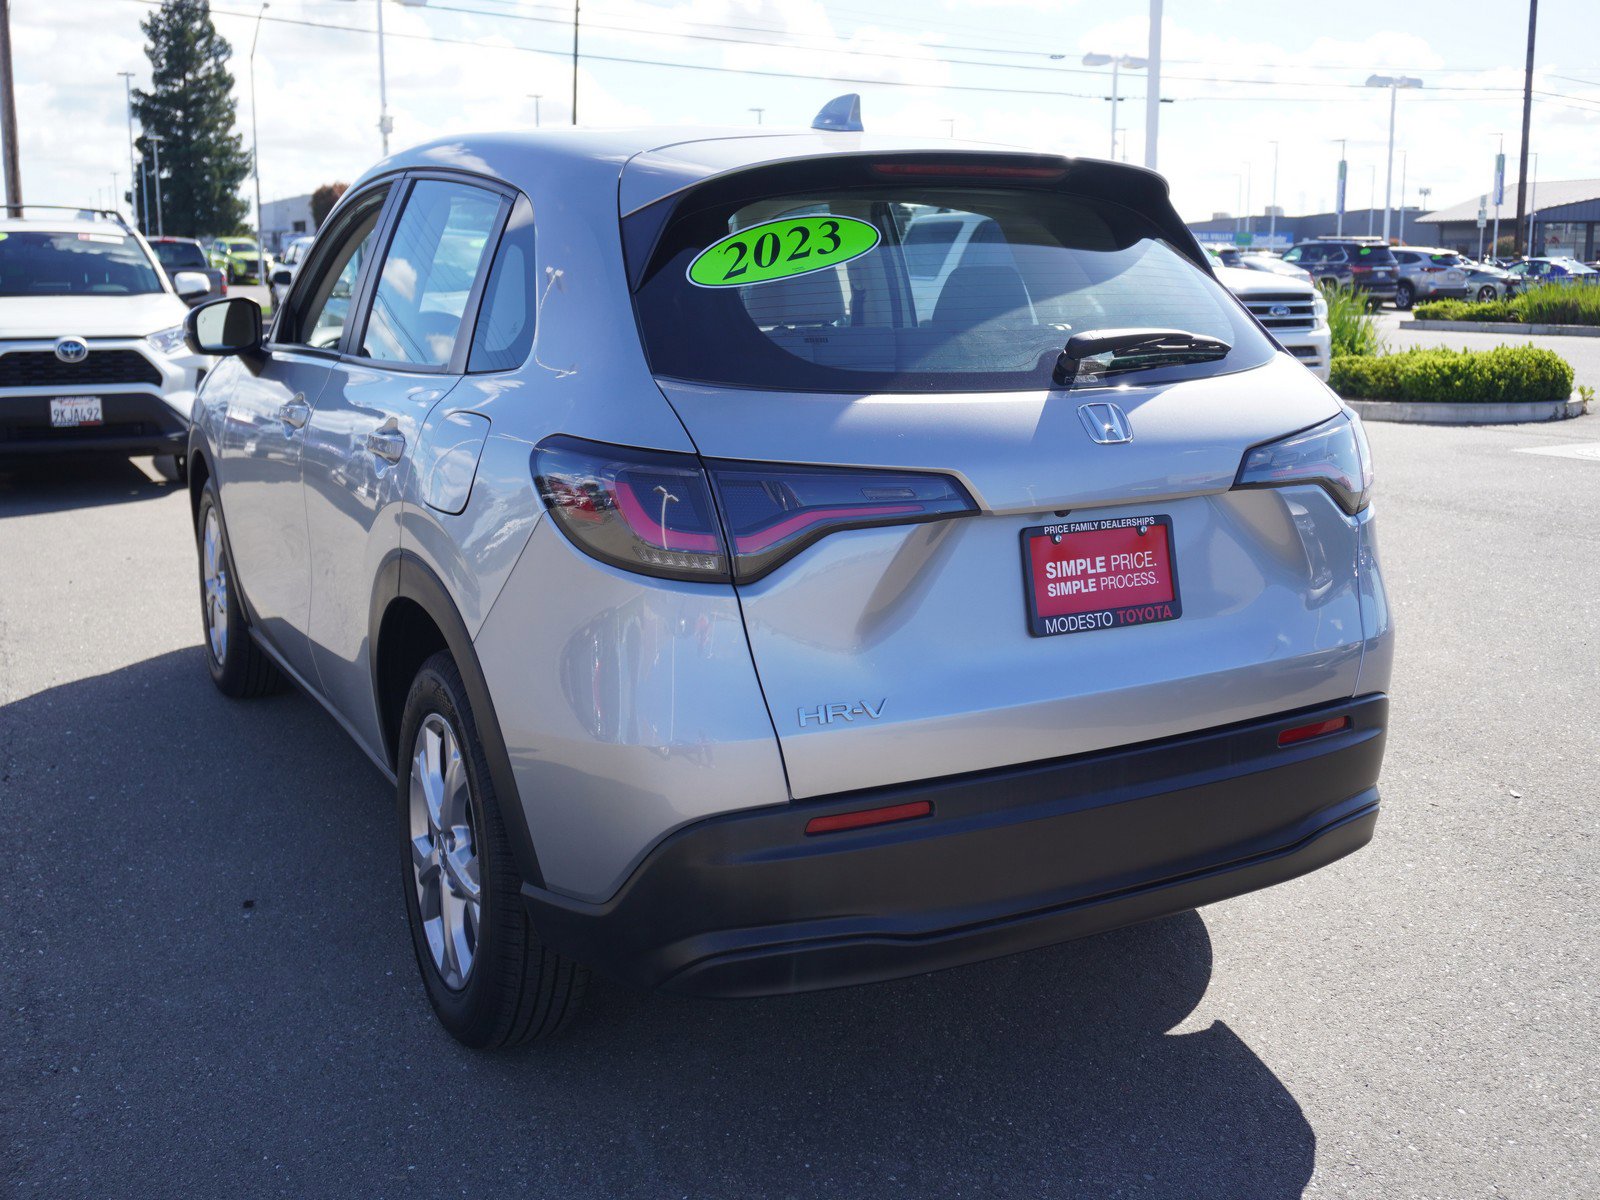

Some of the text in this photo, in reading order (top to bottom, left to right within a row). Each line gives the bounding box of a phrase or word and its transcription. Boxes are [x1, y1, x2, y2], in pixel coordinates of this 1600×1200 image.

[722, 221, 842, 281] 2023
[1044, 516, 1155, 535] PRICE FAMILY DEALERSHIPS
[1045, 551, 1157, 579] SIMPLE PRICE.
[1047, 571, 1159, 597] SIMPLE PROCESS.
[1045, 605, 1173, 634] MODESTO TOYOTA
[798, 697, 888, 727] HR-V
